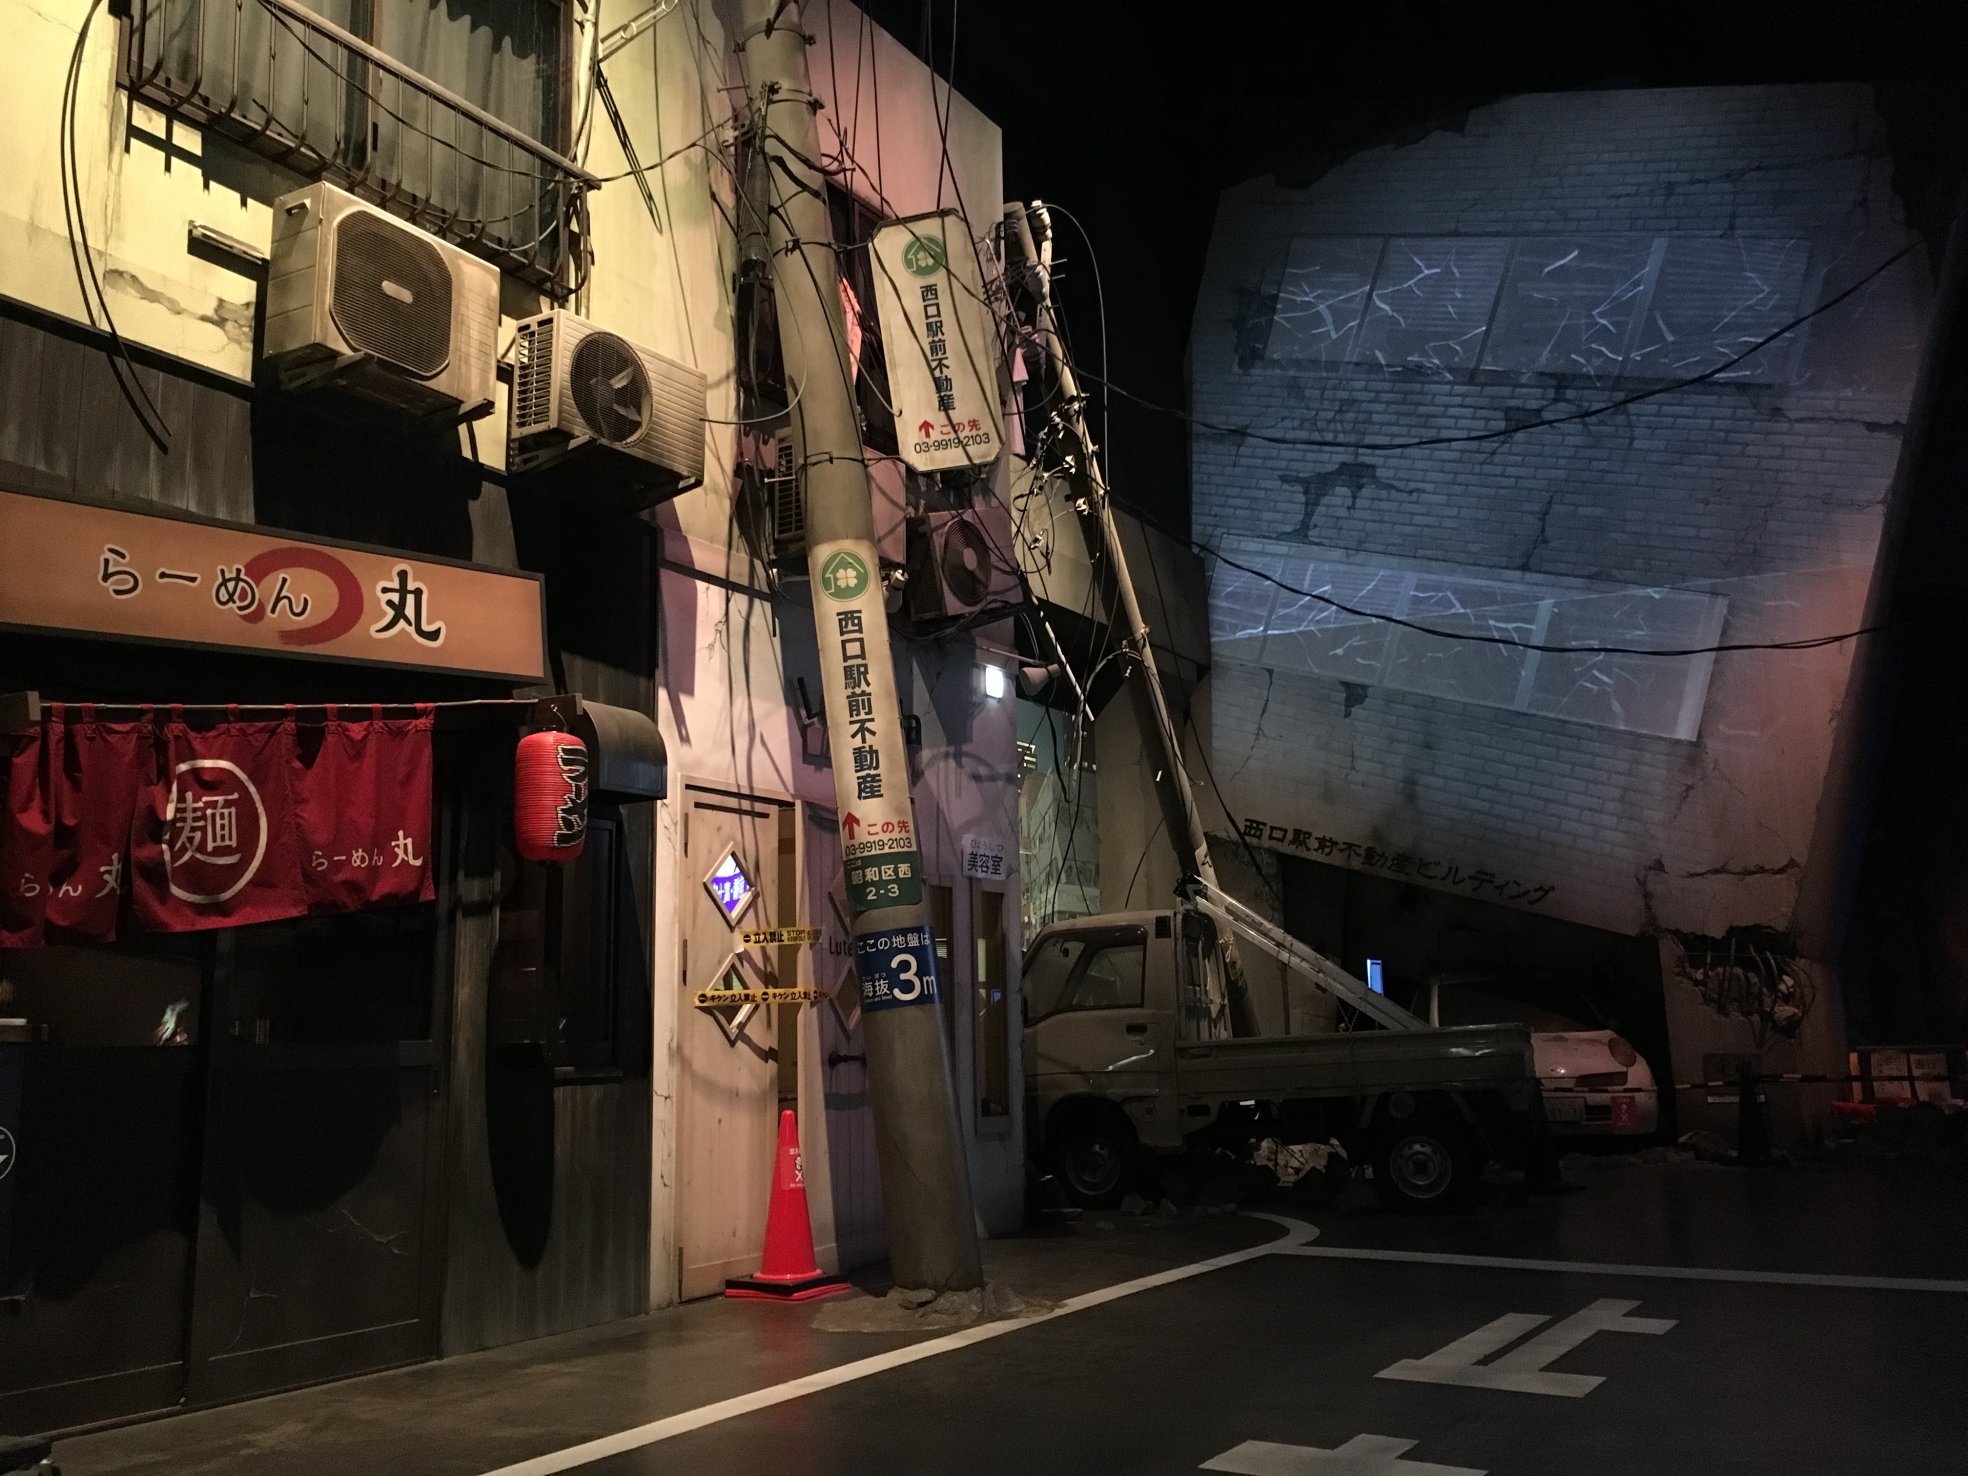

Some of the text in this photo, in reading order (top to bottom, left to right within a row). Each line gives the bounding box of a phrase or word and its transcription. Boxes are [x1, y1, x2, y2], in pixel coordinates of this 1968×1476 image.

[919, 283, 957, 413] 西口駅前不動産
[940, 419, 982, 436] この先
[914, 432, 991, 454] 03-9919-2103
[100, 546, 444, 645] らーめん 丸
[836, 608, 885, 801] 西口駅前不動産
[553, 744, 588, 848] ラーメン
[173, 791, 242, 868] 麺
[867, 819, 911, 836] この先
[311, 829, 423, 872] らーめん 丸
[845, 837, 913, 857] 03-9919-2103
[967, 851, 1003, 875] 美容室
[1242, 817, 1557, 906] 西口駅前不動産ビルディング
[850, 863, 912, 885] 昭和区西
[866, 883, 900, 900] 2-3
[753, 931, 785, 944] 立入禁止
[857, 932, 931, 955] ここの地盤は
[862, 979, 891, 998] 海抜
